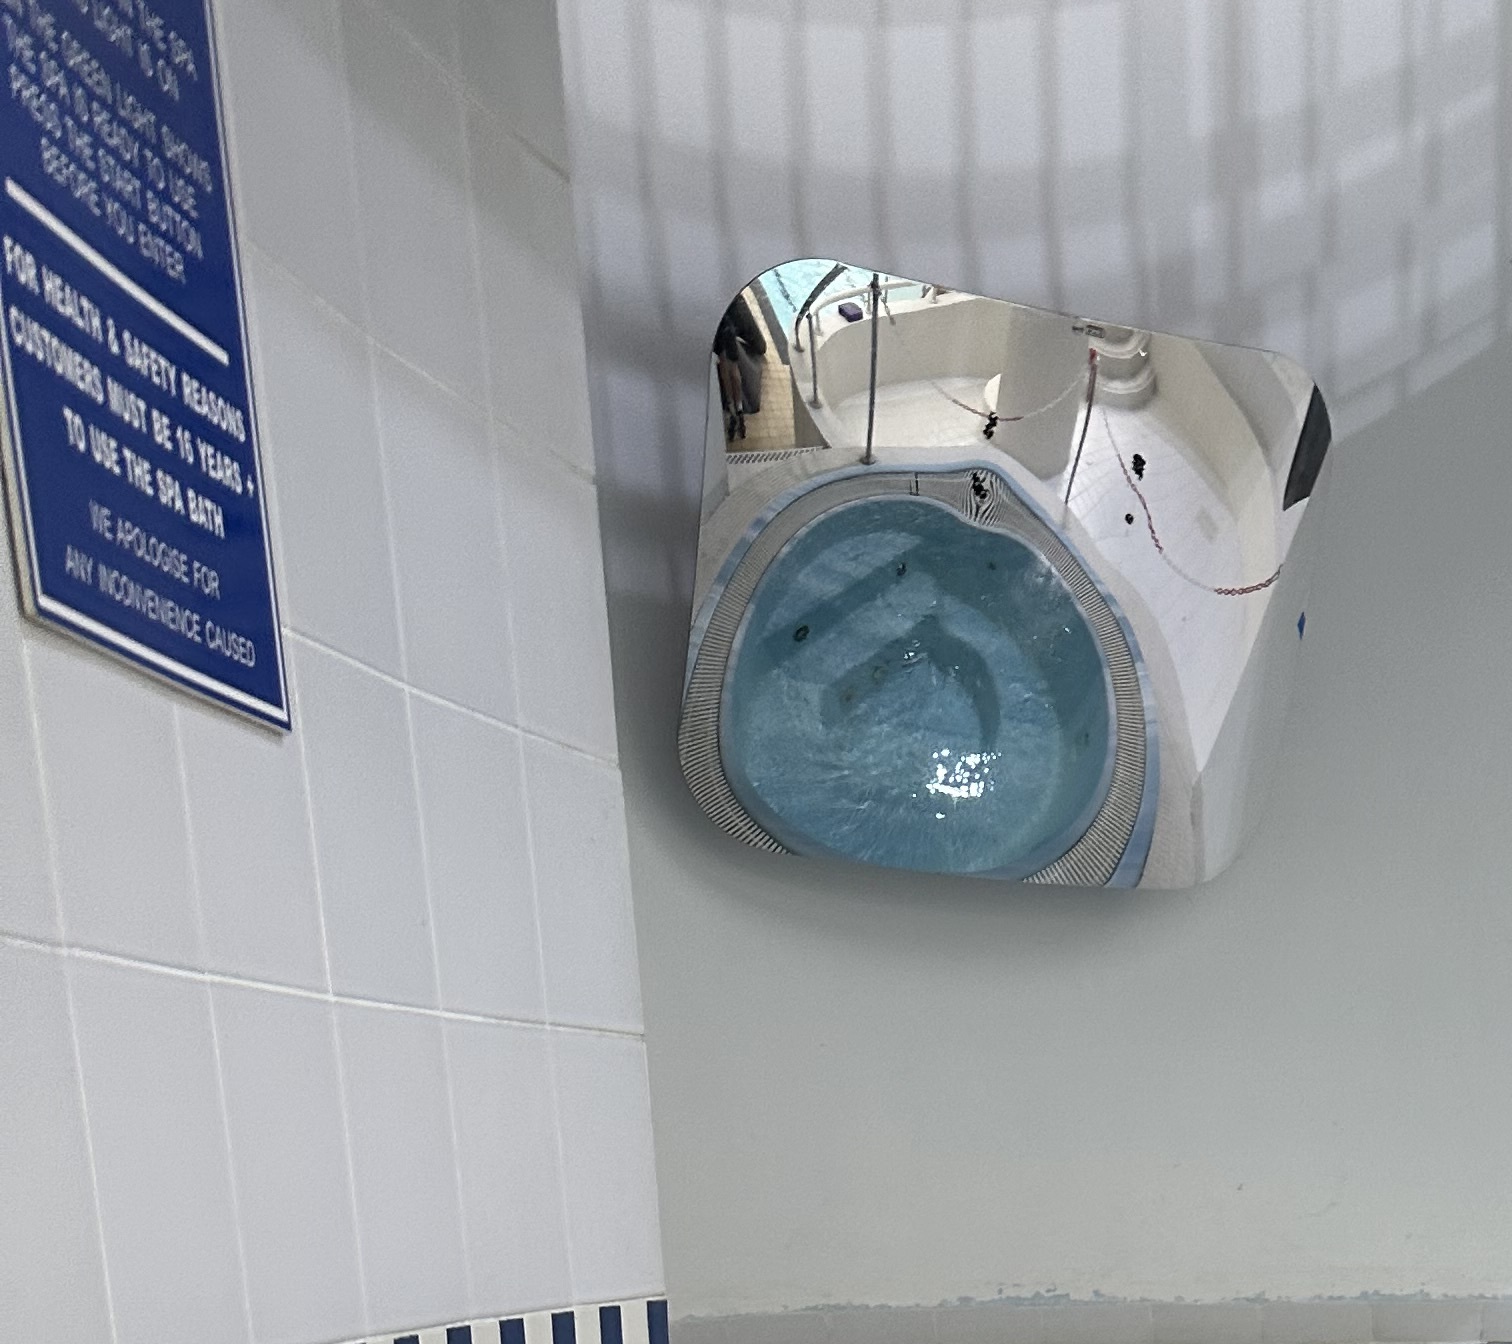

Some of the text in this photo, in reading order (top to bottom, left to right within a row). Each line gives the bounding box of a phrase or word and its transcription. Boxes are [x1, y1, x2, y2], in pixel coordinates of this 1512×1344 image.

[41, 136, 186, 285] BEFORE YOU ENTER
[147, 190, 204, 260] BUTTON
[3, 234, 246, 444] FOR HEALTH & SAFETY REASONS
[9, 304, 104, 405] CUSTOMERS
[107, 376, 147, 433] MUST
[151, 408, 173, 450] BE
[196, 436, 243, 495] YEARS
[63, 405, 225, 540] TO USE THE SPA BATH
[65, 545, 256, 668] ANY INCONVENIENCE CAUSED
[89, 499, 220, 600] WE APOLOGISE FOR
